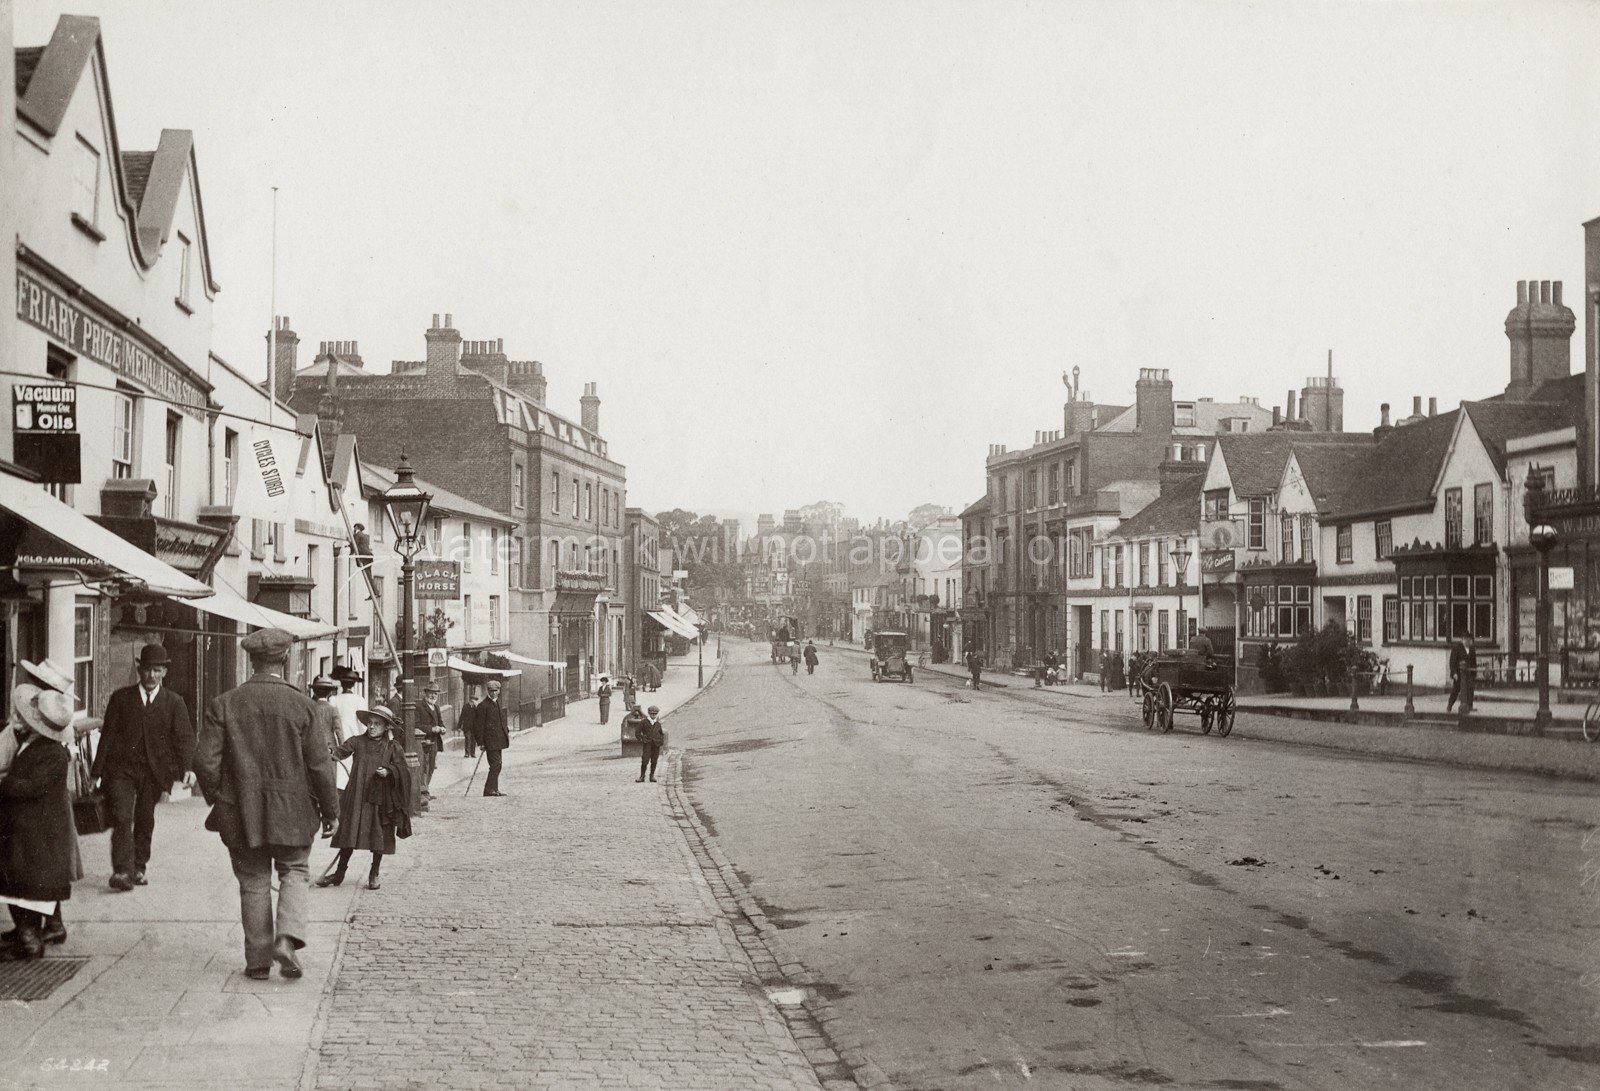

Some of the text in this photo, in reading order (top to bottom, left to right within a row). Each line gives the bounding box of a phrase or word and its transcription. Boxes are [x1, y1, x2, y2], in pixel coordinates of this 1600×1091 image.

[18, 275, 79, 344] FRIARY
[82, 316, 121, 368] PRIZE
[124, 341, 156, 389] MEDAL
[14, 385, 75, 403] Vacuum
[38, 413, 74, 430] Oils
[253, 439, 285, 497] CYCLES STORED
[416, 569, 459, 581] BLACK
[418, 582, 456, 591] HORSE
